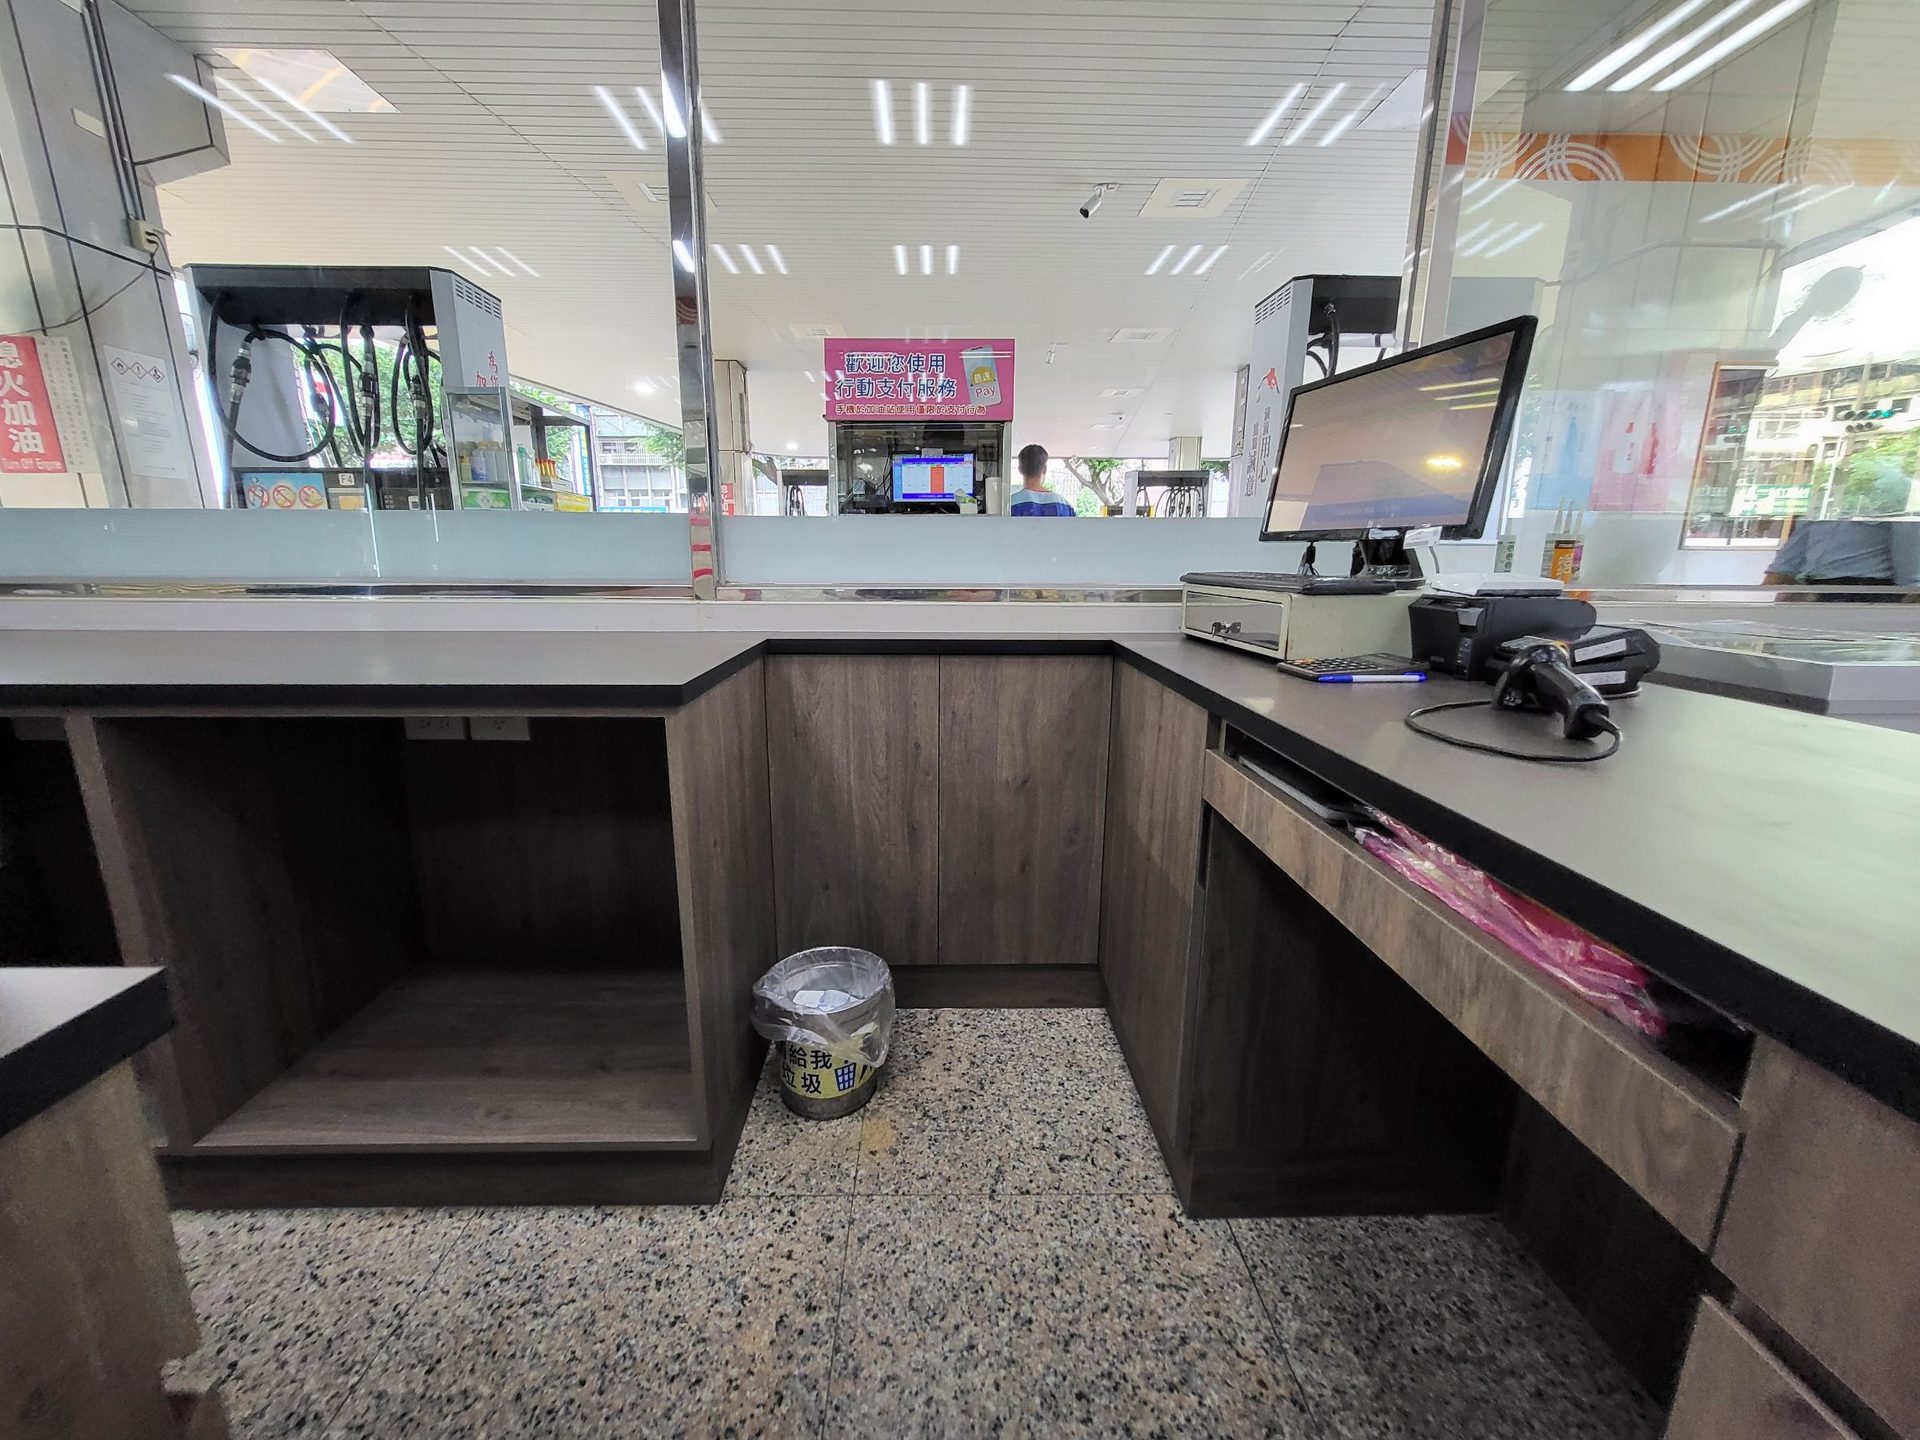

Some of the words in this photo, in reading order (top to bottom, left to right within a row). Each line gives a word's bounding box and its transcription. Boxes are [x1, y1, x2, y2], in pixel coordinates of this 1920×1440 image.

[845, 352, 946, 374] 歡迎您使用
[836, 377, 957, 398] 行動支付服務
[976, 387, 996, 398] Pay
[783, 1045, 832, 1070] 給我
[782, 1064, 822, 1094] 垃圾
